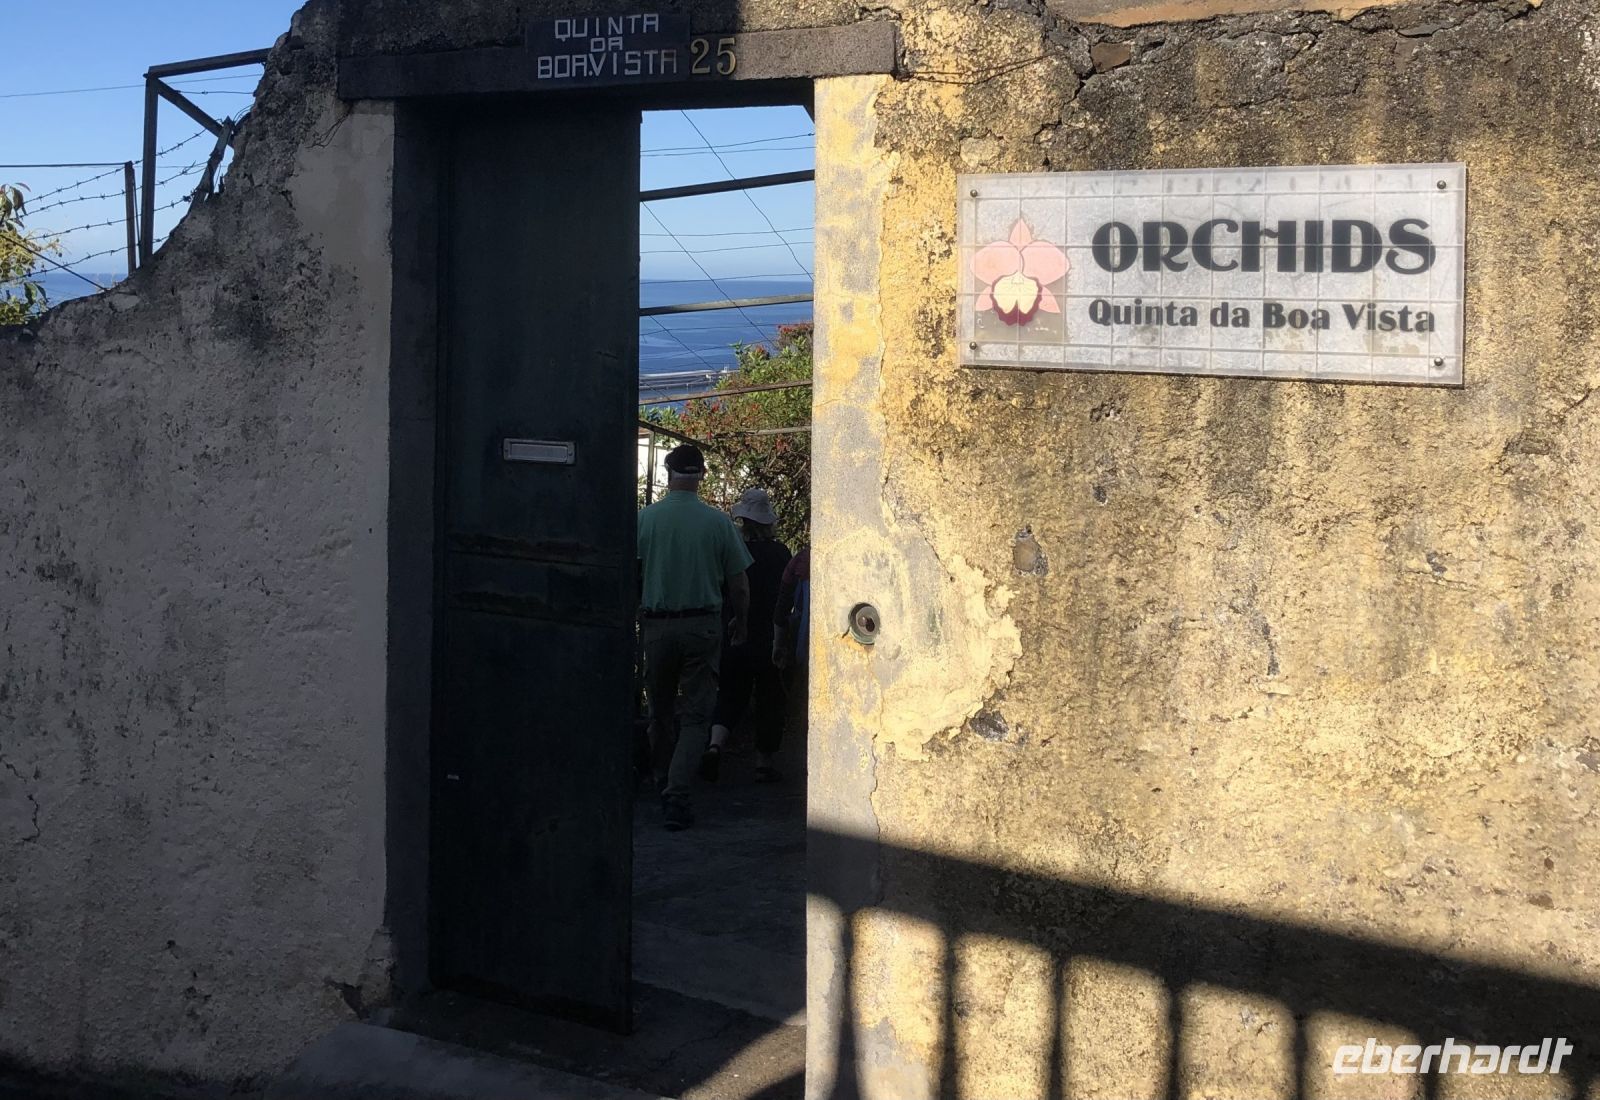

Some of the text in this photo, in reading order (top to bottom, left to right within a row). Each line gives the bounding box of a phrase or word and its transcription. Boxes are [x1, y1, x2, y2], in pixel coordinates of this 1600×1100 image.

[555, 13, 659, 41] QUINTA
[590, 36, 623, 52] DA
[691, 37, 737, 76] 25
[1091, 218, 1436, 275] ORCHIDS
[1088, 299, 1436, 333] Quinta da Boa Vista
